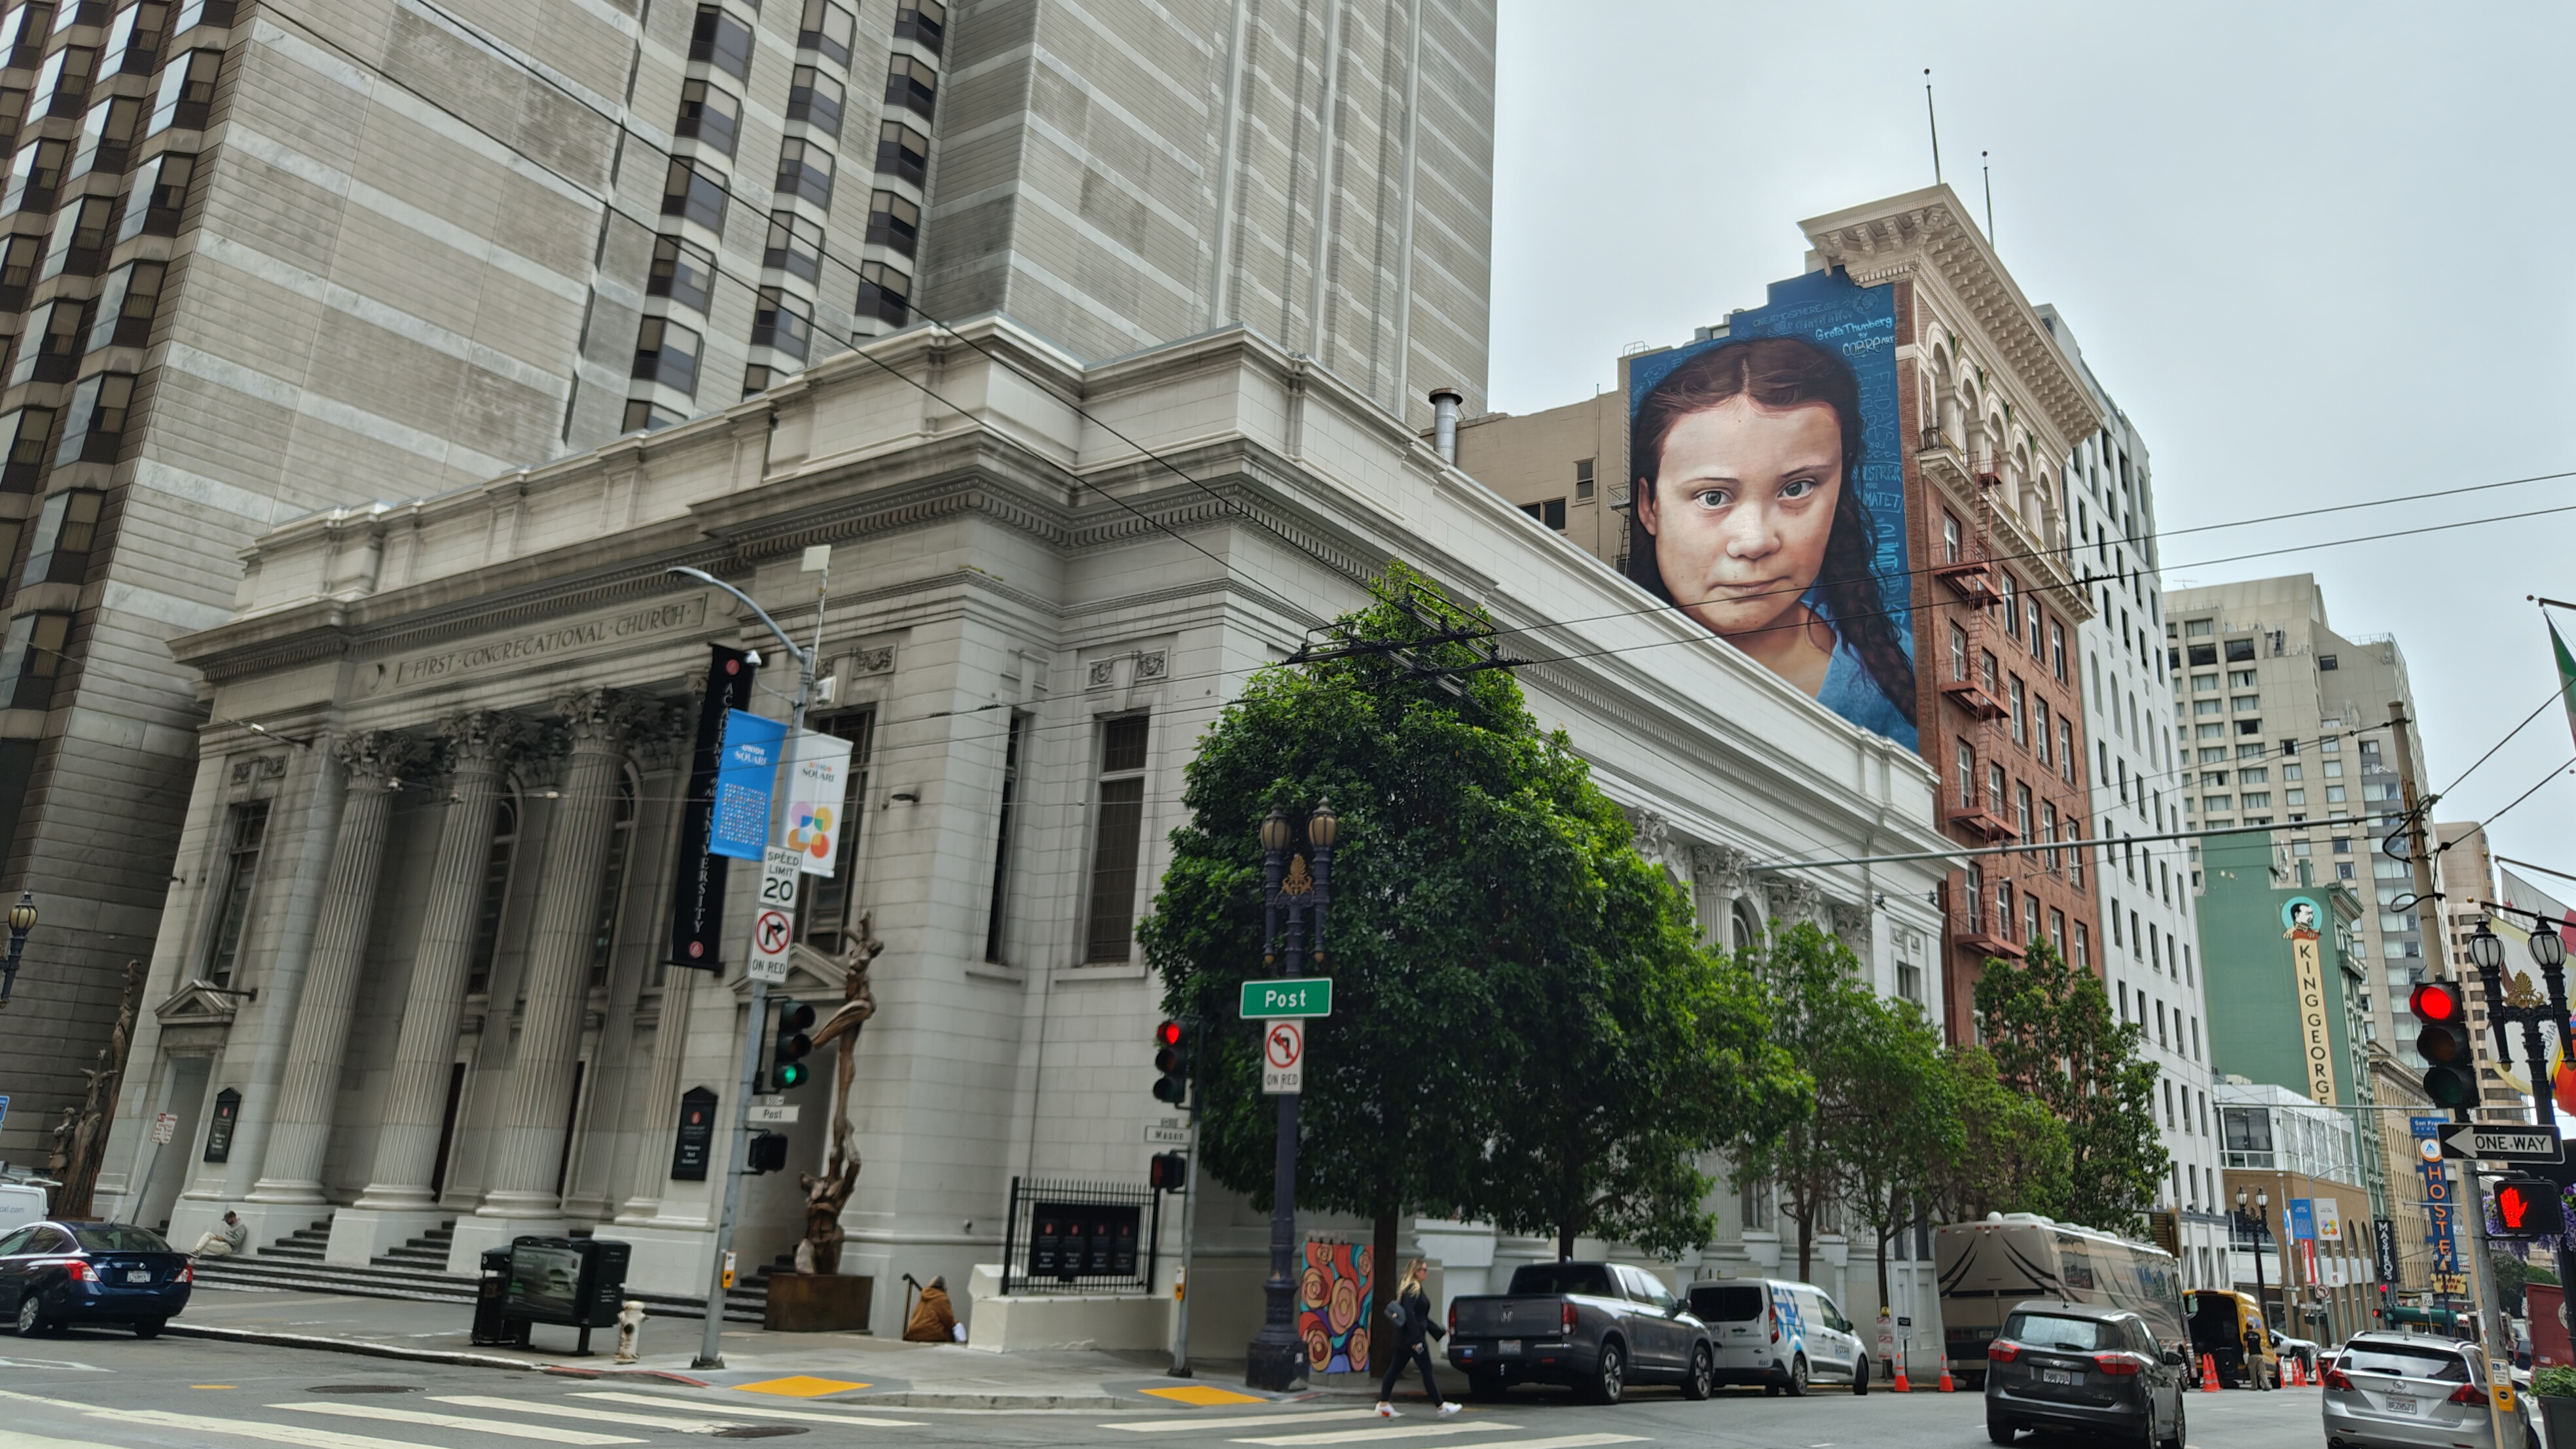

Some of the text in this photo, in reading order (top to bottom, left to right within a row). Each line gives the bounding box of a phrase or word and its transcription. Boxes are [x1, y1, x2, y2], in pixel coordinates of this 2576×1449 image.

[1843, 317, 1893, 334] Thunberg
[413, 654, 456, 679] FIRST
[615, 604, 686, 636] CHURCH
[742, 743, 765, 756] UNION
[809, 762, 833, 772] UNION
[768, 851, 799, 867] SPEED
[769, 865, 794, 878] LIMIT
[763, 877, 794, 901] 20
[753, 959, 786, 975] ON RED
[2299, 944, 2319, 1008] KING
[1265, 989, 1307, 1009] Post
[1265, 1073, 1299, 1085] ON RED
[763, 1108, 783, 1120] Post
[2475, 1136, 2547, 1151] ONE WAY
[2378, 1222, 2393, 1280] MASTRO'S
